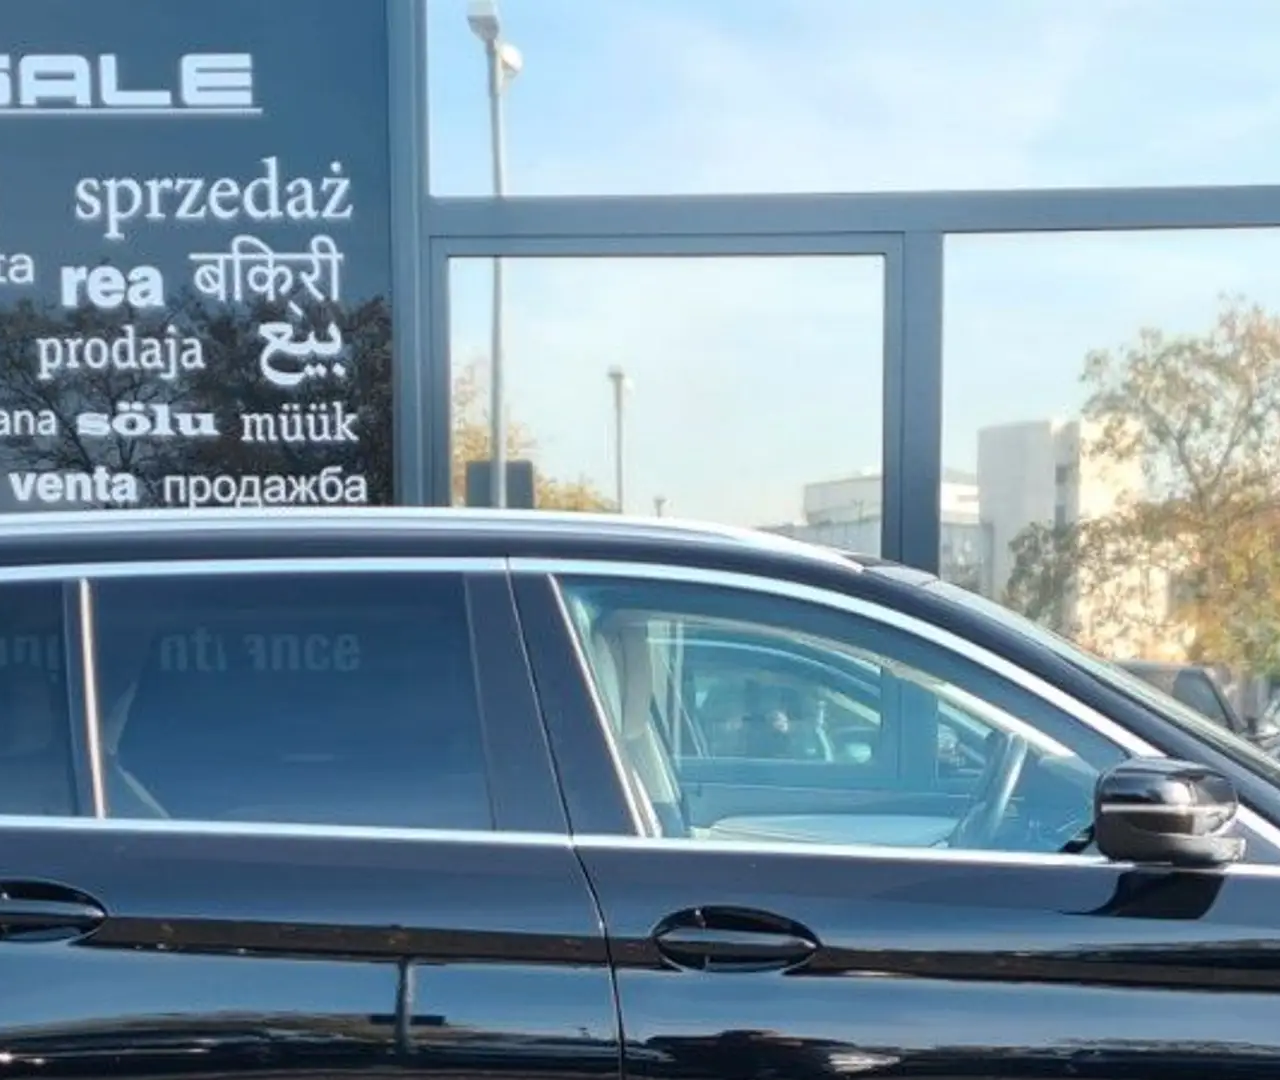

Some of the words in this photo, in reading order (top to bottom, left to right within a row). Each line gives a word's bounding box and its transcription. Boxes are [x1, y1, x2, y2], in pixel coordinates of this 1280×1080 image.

[75, 156, 353, 240] sprzedaż
[61, 265, 165, 309] rea
[36, 324, 206, 381] prodaja
[76, 401, 220, 437] sölu
[240, 401, 359, 443] müük
[8, 466, 138, 503] venta
[164, 464, 369, 509] продажба
